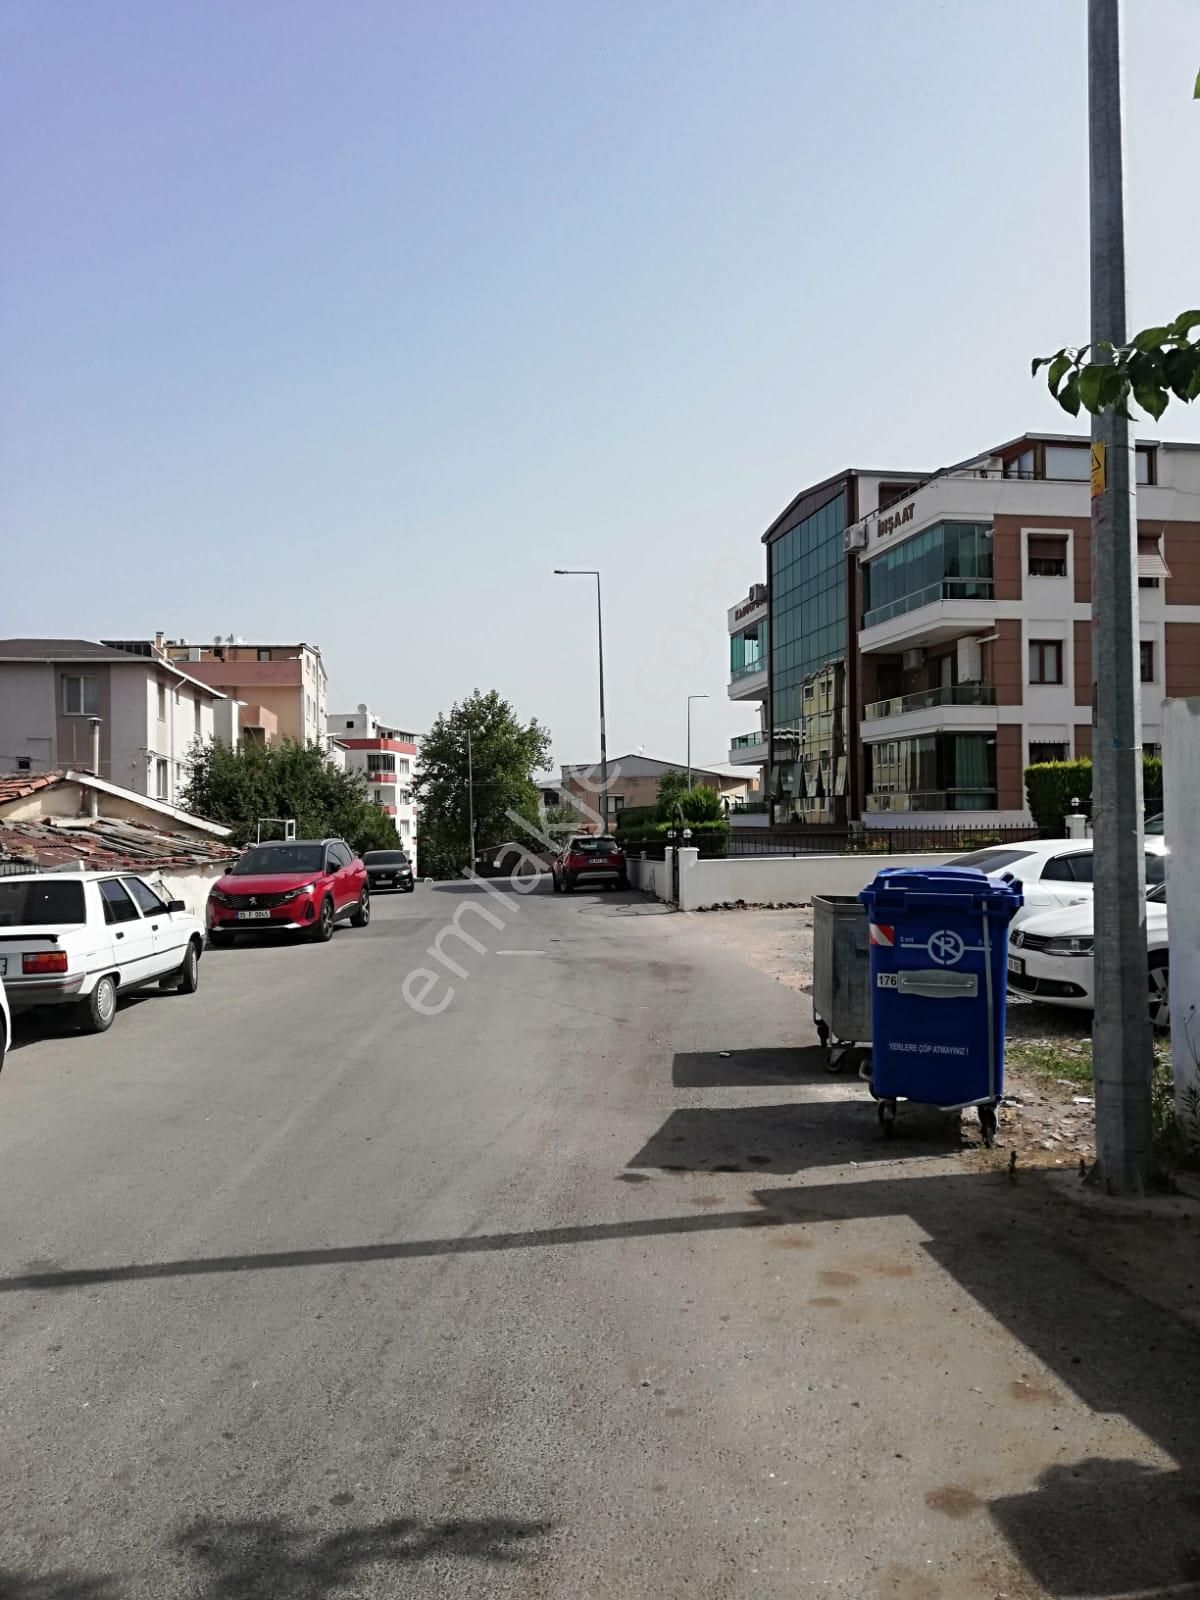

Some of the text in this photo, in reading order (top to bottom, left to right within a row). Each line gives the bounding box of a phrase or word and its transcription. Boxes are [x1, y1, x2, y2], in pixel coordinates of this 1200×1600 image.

[879, 975, 897, 986] 176
[888, 1042, 918, 1052] YERLERE
[919, 1043, 932, 1054] ÇÖP
